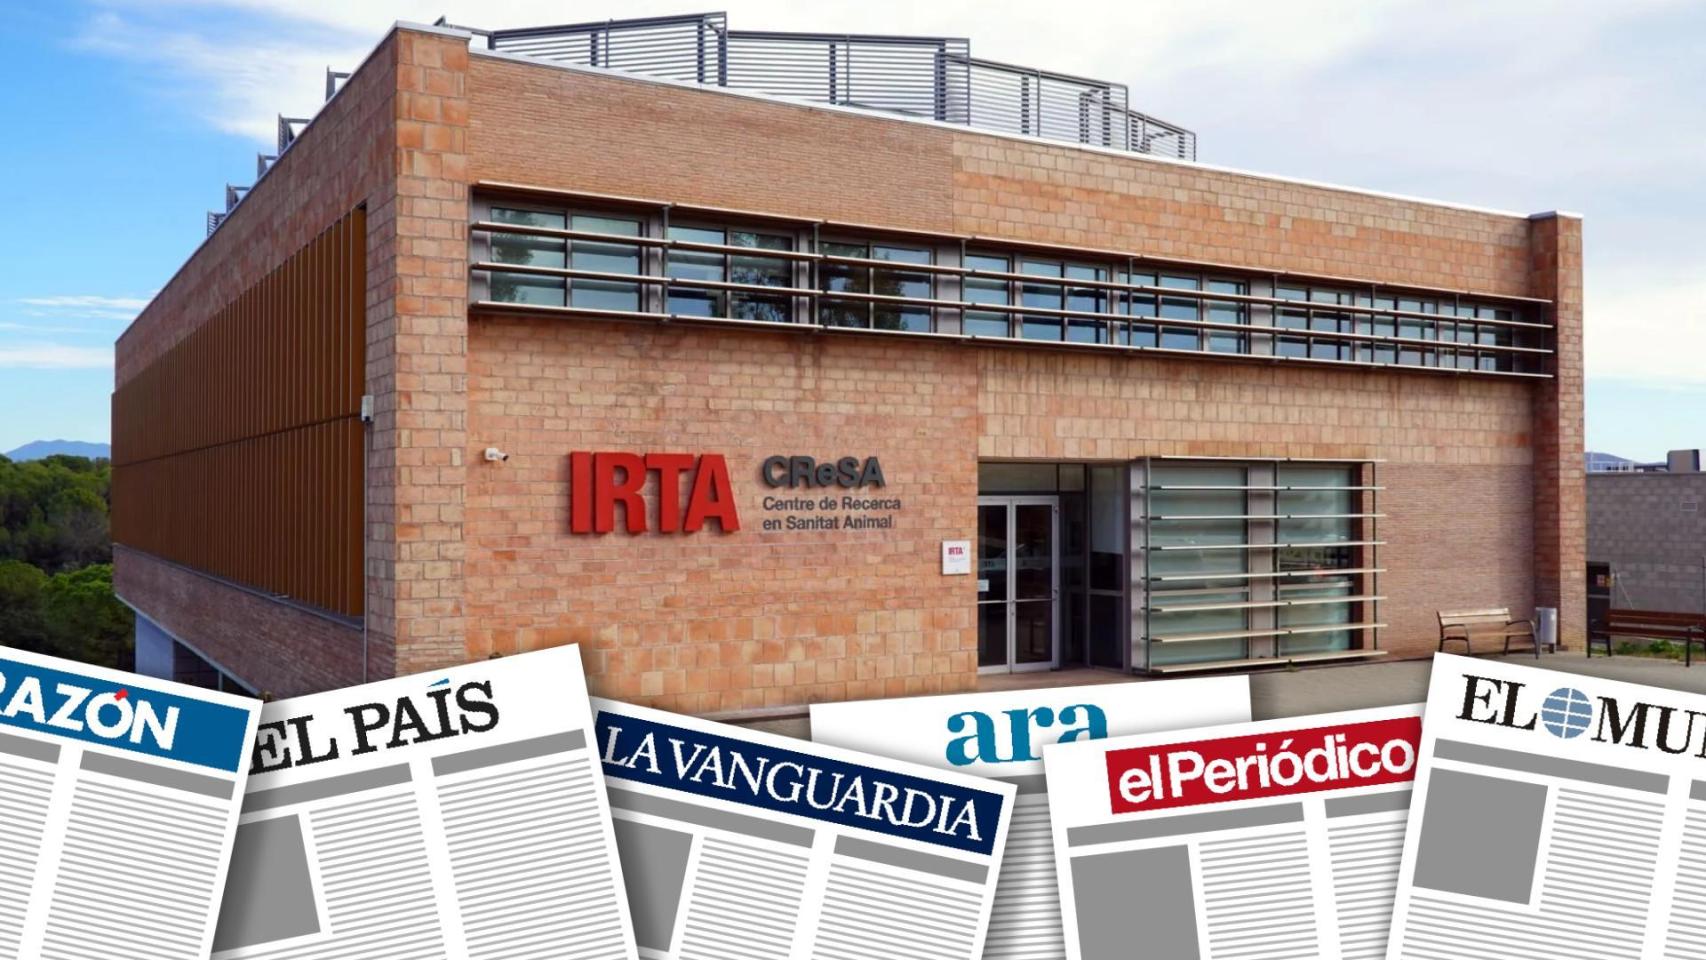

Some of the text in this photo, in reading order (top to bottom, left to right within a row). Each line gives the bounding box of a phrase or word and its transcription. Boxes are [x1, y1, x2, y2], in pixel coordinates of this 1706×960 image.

[763, 455, 886, 488] CReSA
[571, 451, 740, 534] IRTA
[763, 496, 901, 511] Centre de Recerca
[763, 514, 892, 530] en Sanitat Animal
